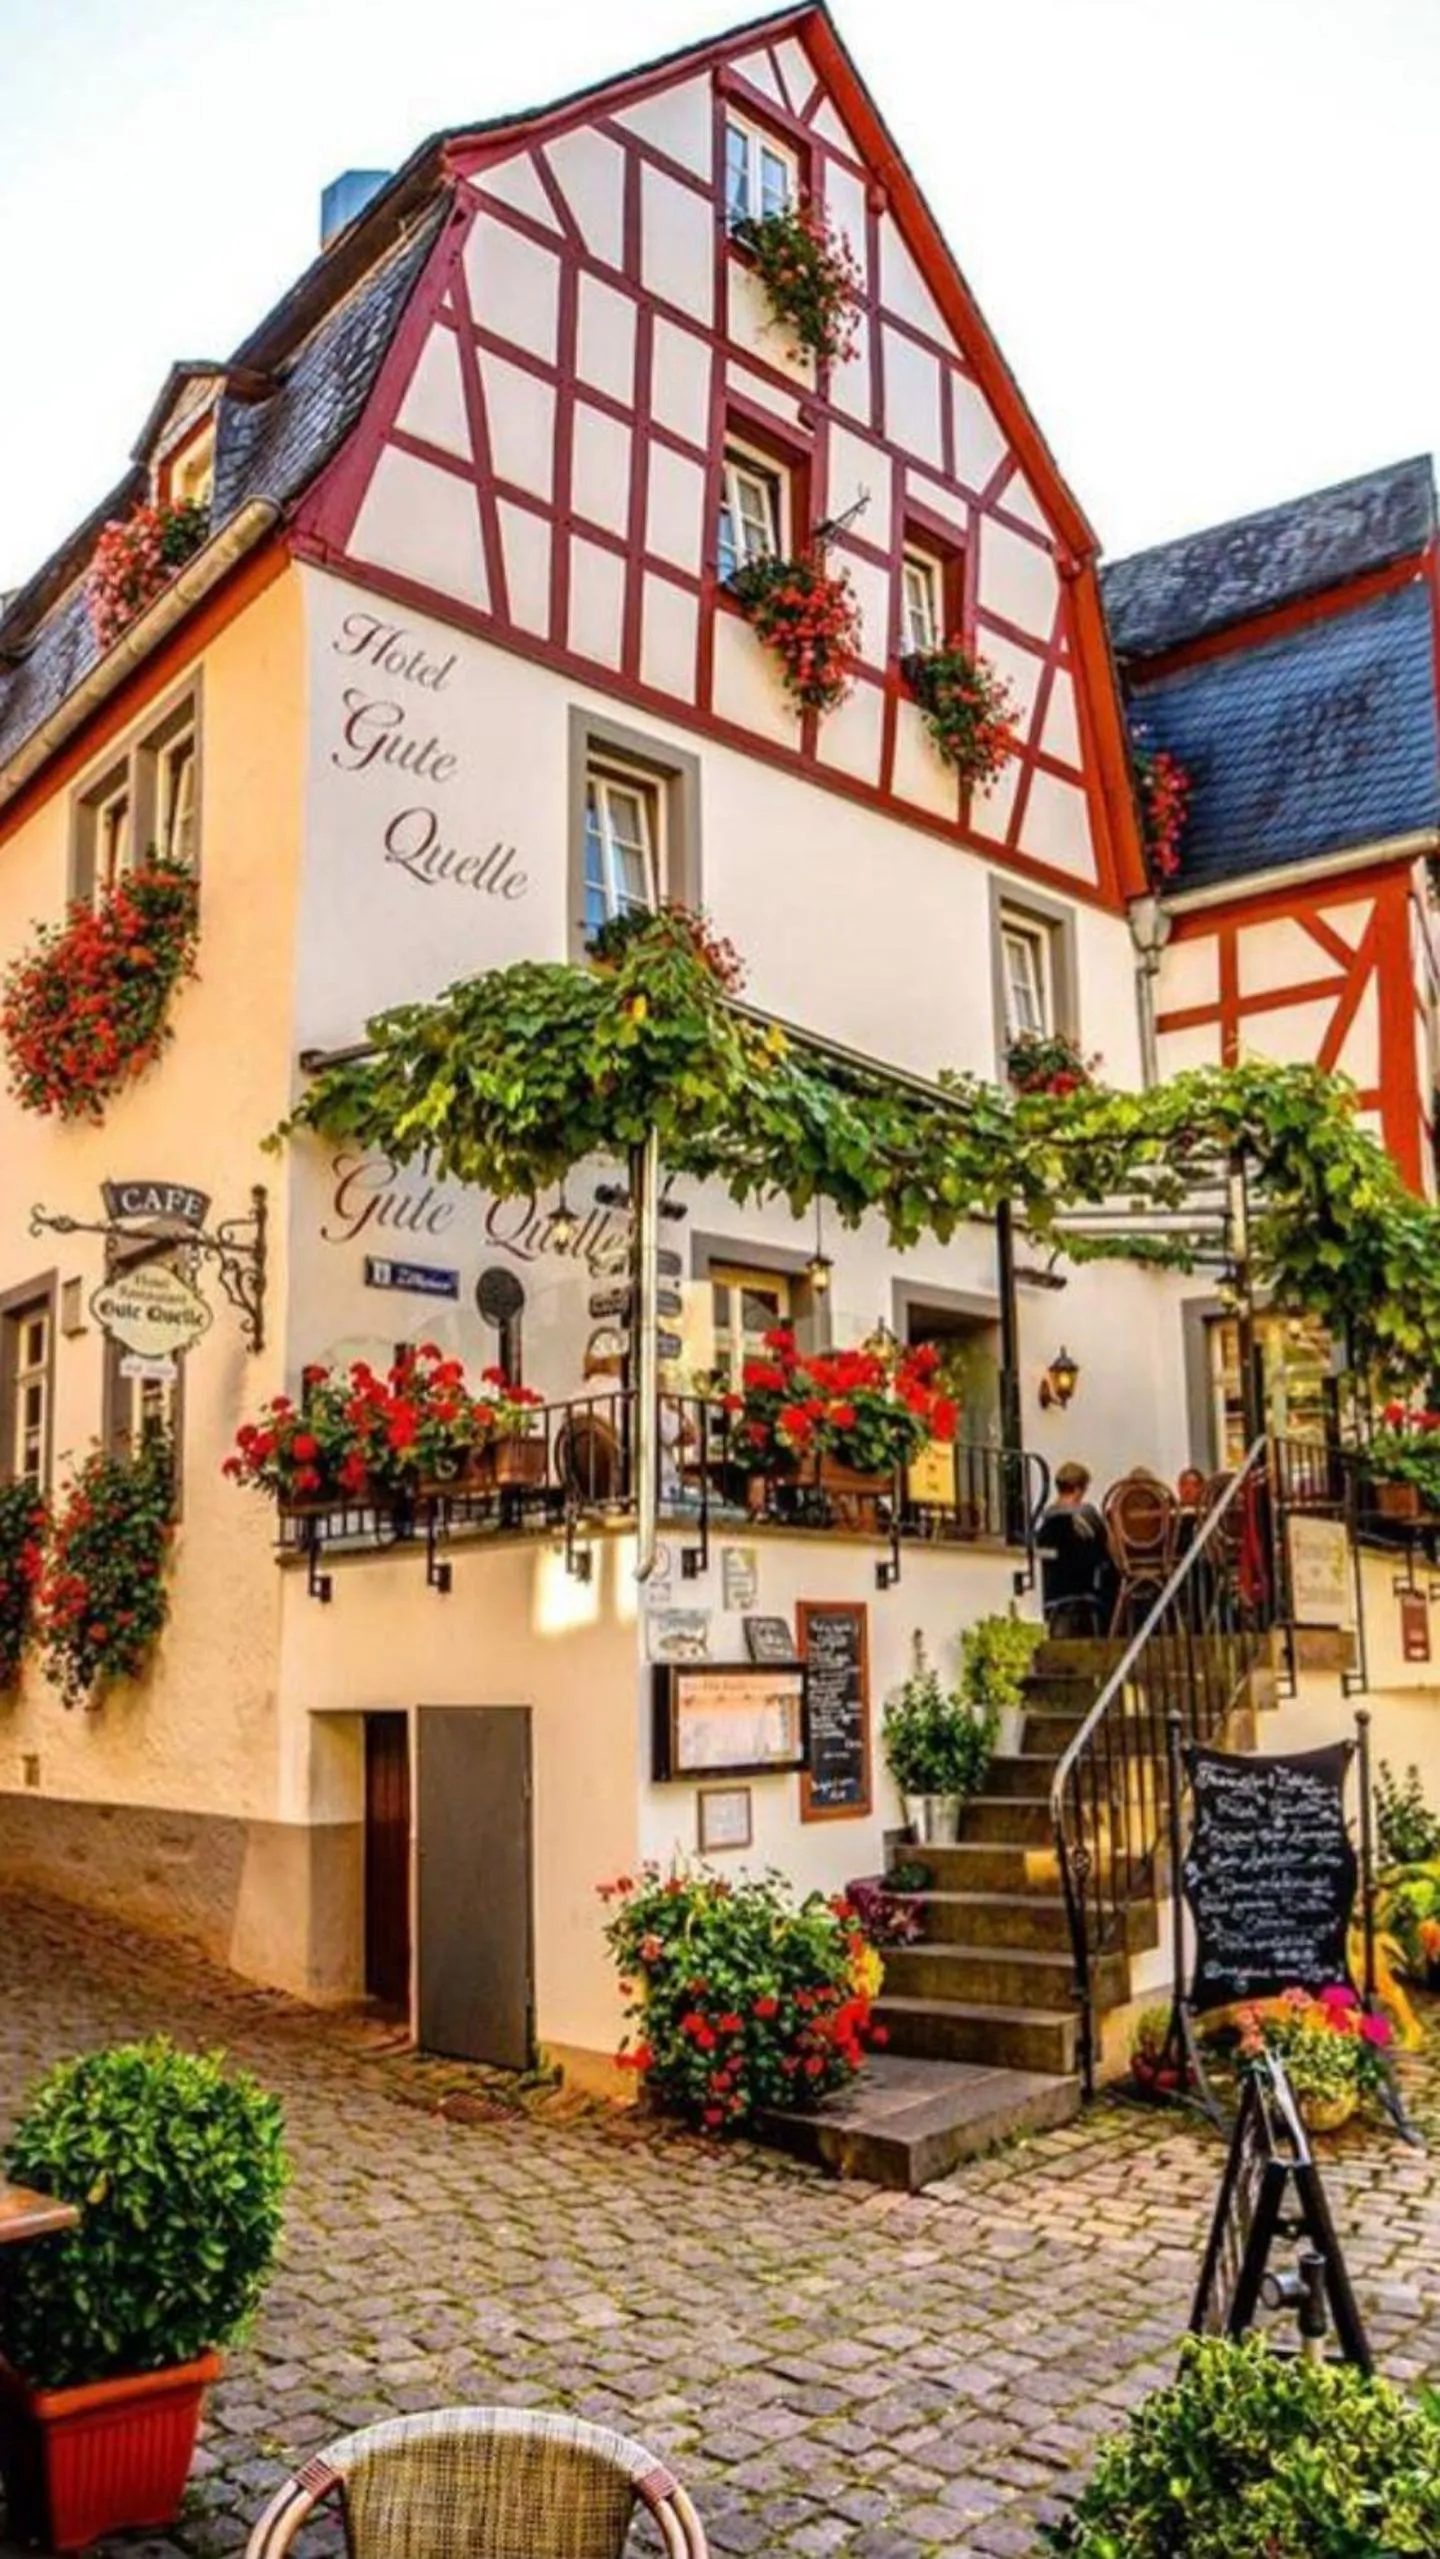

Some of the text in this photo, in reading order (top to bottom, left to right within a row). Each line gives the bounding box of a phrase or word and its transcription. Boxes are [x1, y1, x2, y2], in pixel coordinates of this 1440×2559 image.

[331, 612, 458, 693] Hotel
[331, 686, 458, 784] Gute
[383, 805, 529, 901] Quelle
[121, 1188, 201, 1219] CAFE
[320, 1152, 456, 1243] Gute
